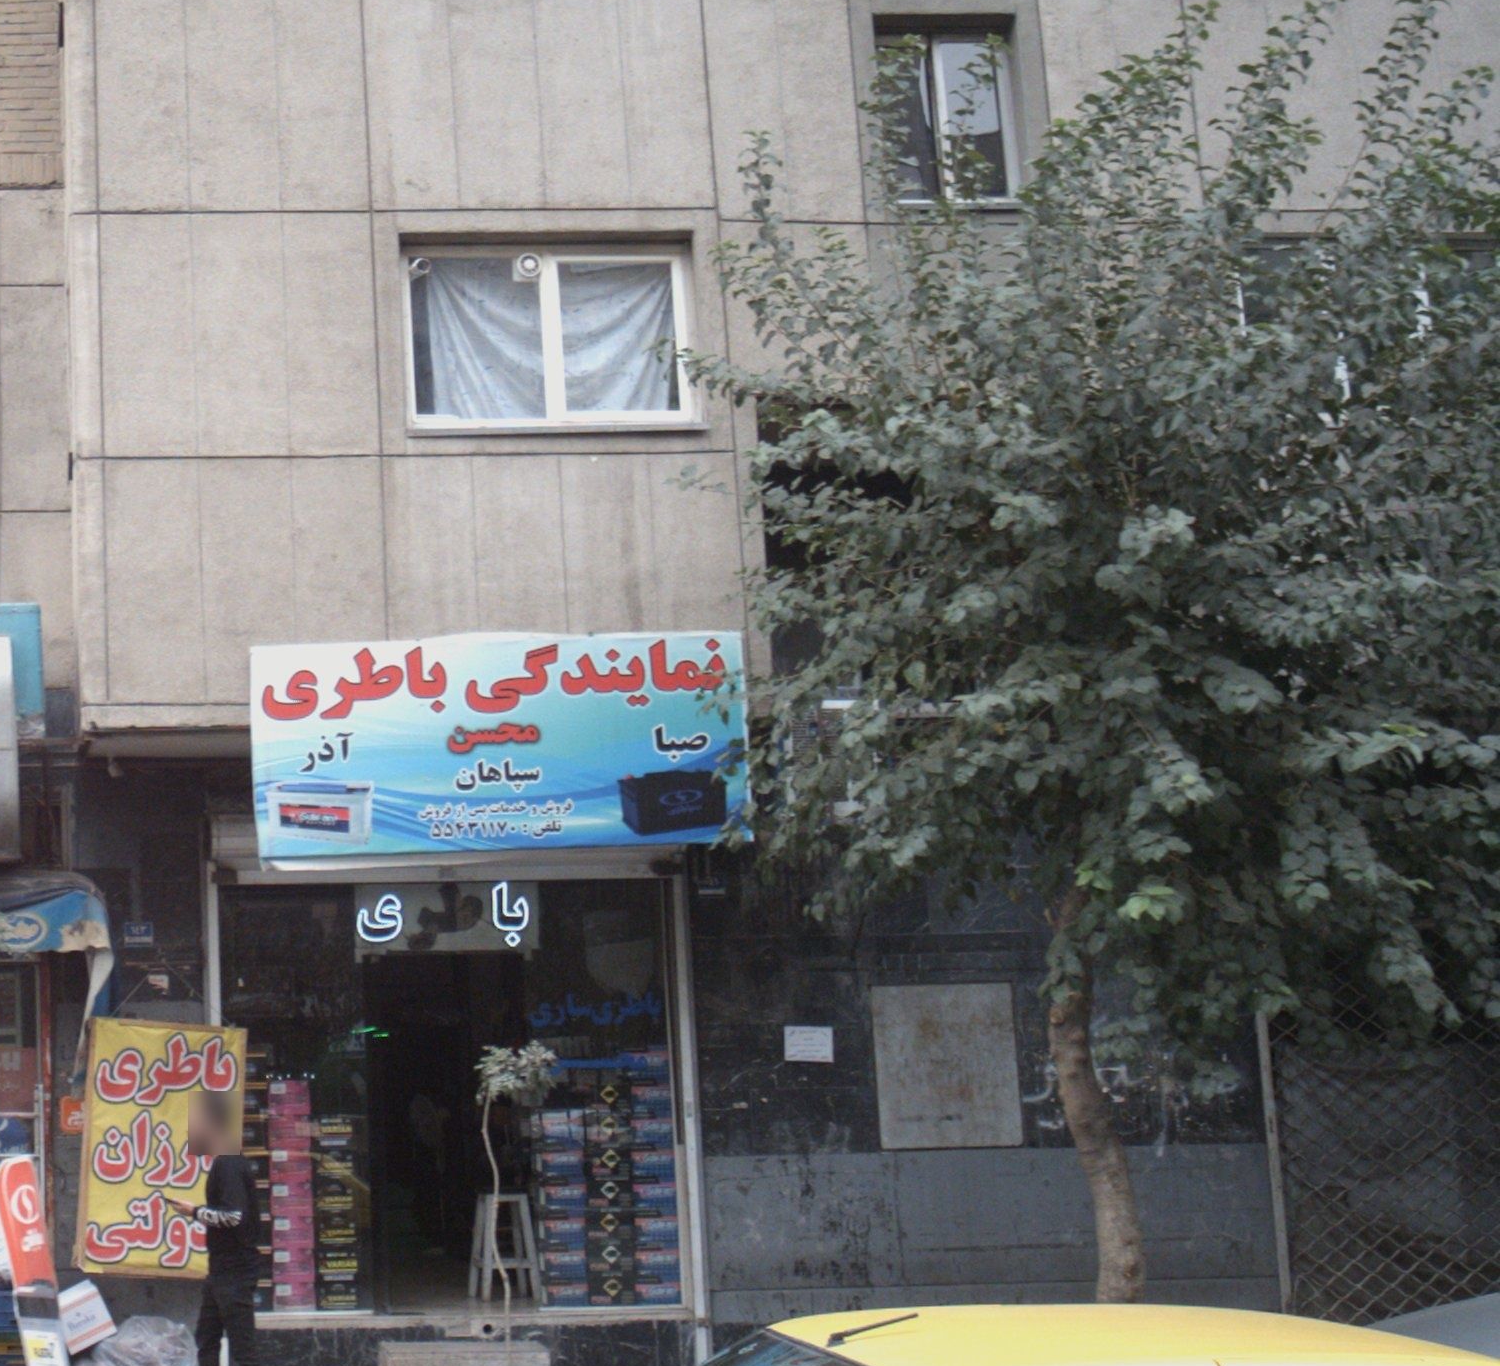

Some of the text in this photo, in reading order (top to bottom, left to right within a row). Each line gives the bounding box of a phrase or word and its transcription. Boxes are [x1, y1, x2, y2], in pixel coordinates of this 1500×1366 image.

[262, 638, 726, 721] نمایندگی باطری
[300, 732, 353, 771] آذر
[448, 719, 541, 754] محسن
[653, 724, 709, 755] صبا
[455, 760, 541, 792] سپاهان
[489, 801, 527, 813] خدمات
[94, 1110, 211, 1188] رزان
